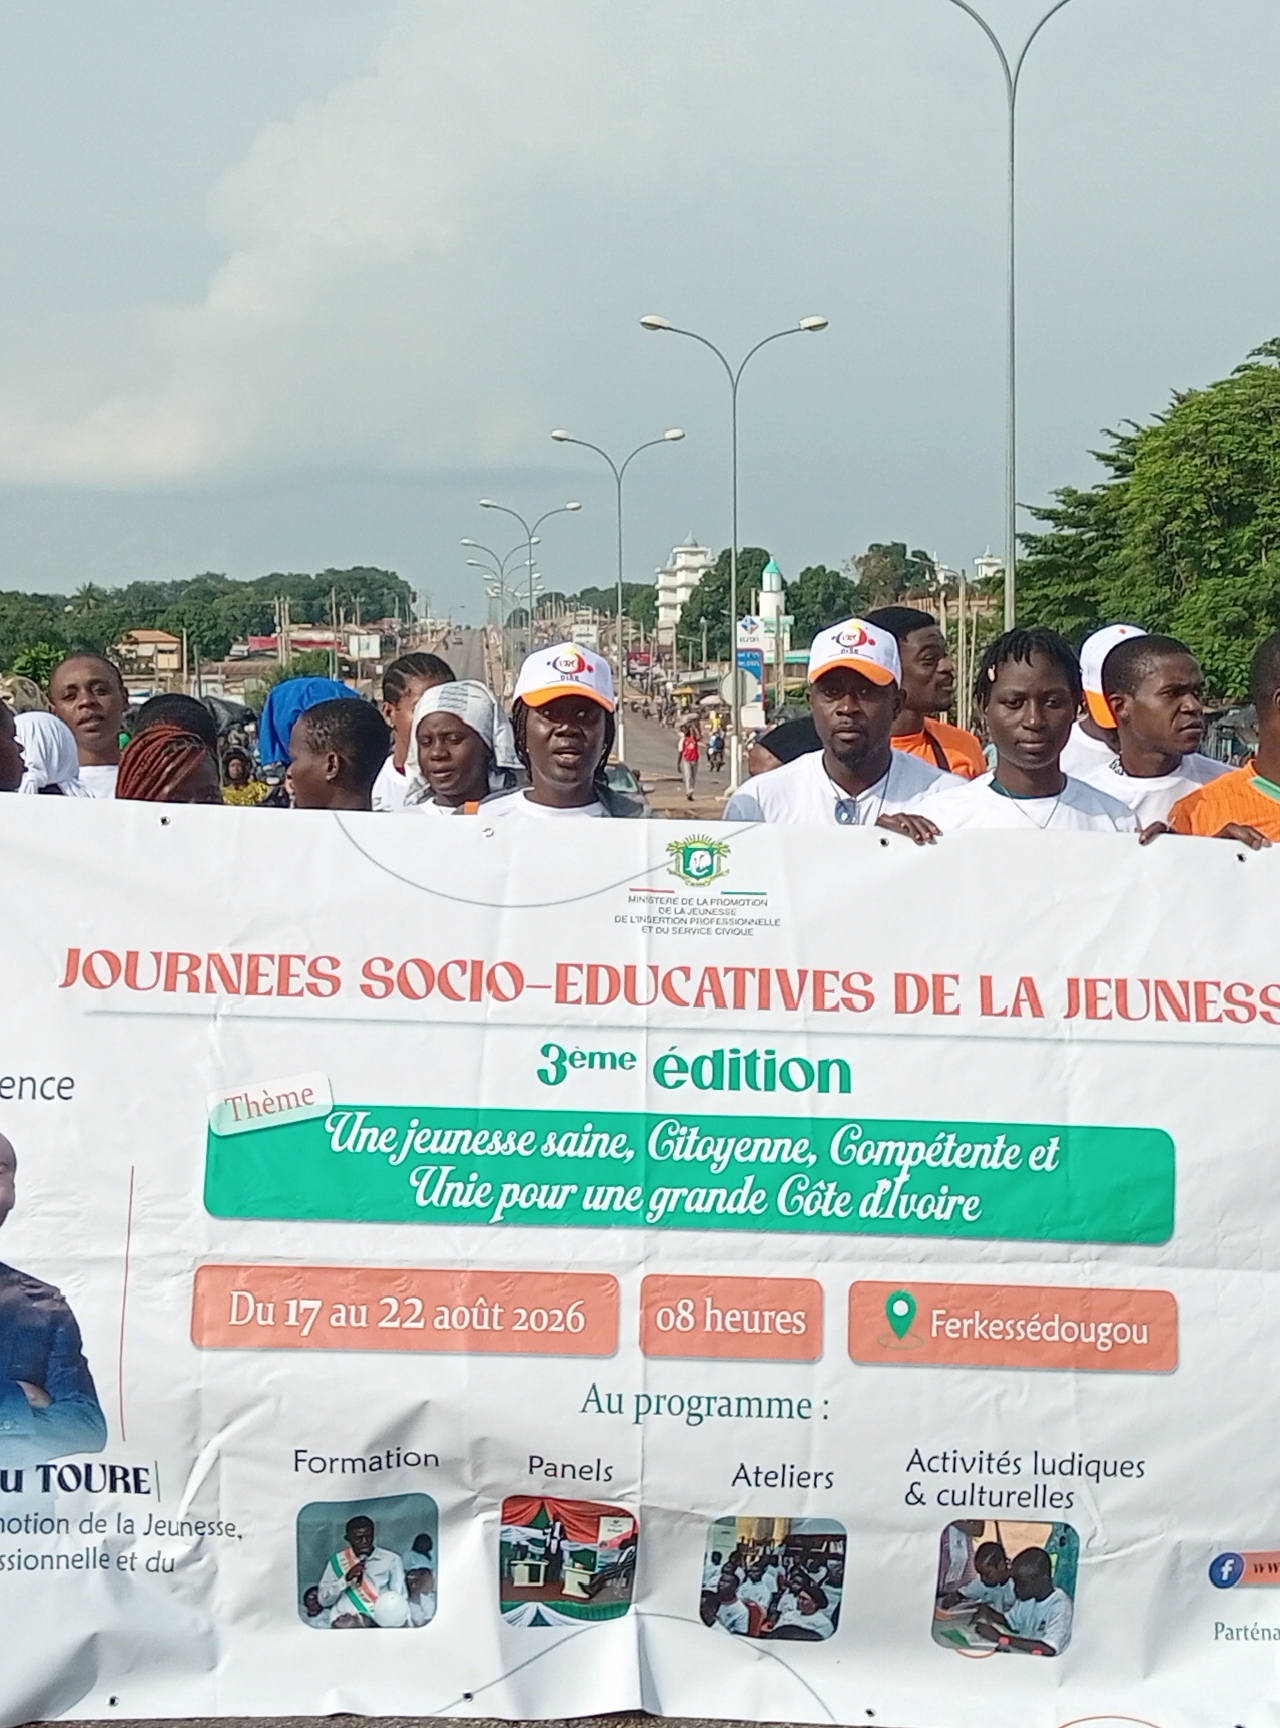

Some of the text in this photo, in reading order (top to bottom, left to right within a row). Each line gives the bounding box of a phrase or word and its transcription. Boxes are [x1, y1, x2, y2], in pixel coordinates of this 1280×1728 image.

[629, 896, 678, 905] MINISTERE
[672, 927, 712, 935] SERVICE
[715, 928, 754, 936] CIVIQUE
[690, 917, 780, 926] PROFESSIONNELLE
[59, 948, 341, 997] JOURNEES
[360, 957, 874, 1013] SOCIO-EDUCATIVES
[894, 973, 959, 1015] DE
[980, 975, 1044, 1018] LA
[537, 1044, 851, 1093] 3ème édition
[224, 1083, 316, 1125] Thème
[325, 1112, 1060, 1182] Une jeunesse saine, Citoyenne, Compétente et
[410, 1166, 983, 1226] Unie pour une grande Côte d'Ivoire
[228, 1290, 585, 1335] Du 17 au 22 août 2026
[655, 1296, 807, 1337] 08 heures
[929, 1308, 1150, 1351] Ferkessédougou
[579, 1382, 624, 1415] Au
[633, 1394, 811, 1426] programme
[294, 1446, 440, 1474] Formation
[529, 1456, 613, 1482] Panels
[732, 1463, 833, 1489] Ateliers
[906, 1448, 1144, 1483] Activités ludiques
[35, 1463, 152, 1497] TOURE
[905, 1482, 1074, 1509] & culturelles
[79, 1512, 106, 1534] de
[117, 1512, 134, 1534] la
[143, 1513, 243, 1541] Jeunesse,
[116, 1553, 137, 1571] et
[146, 1551, 174, 1573] du
